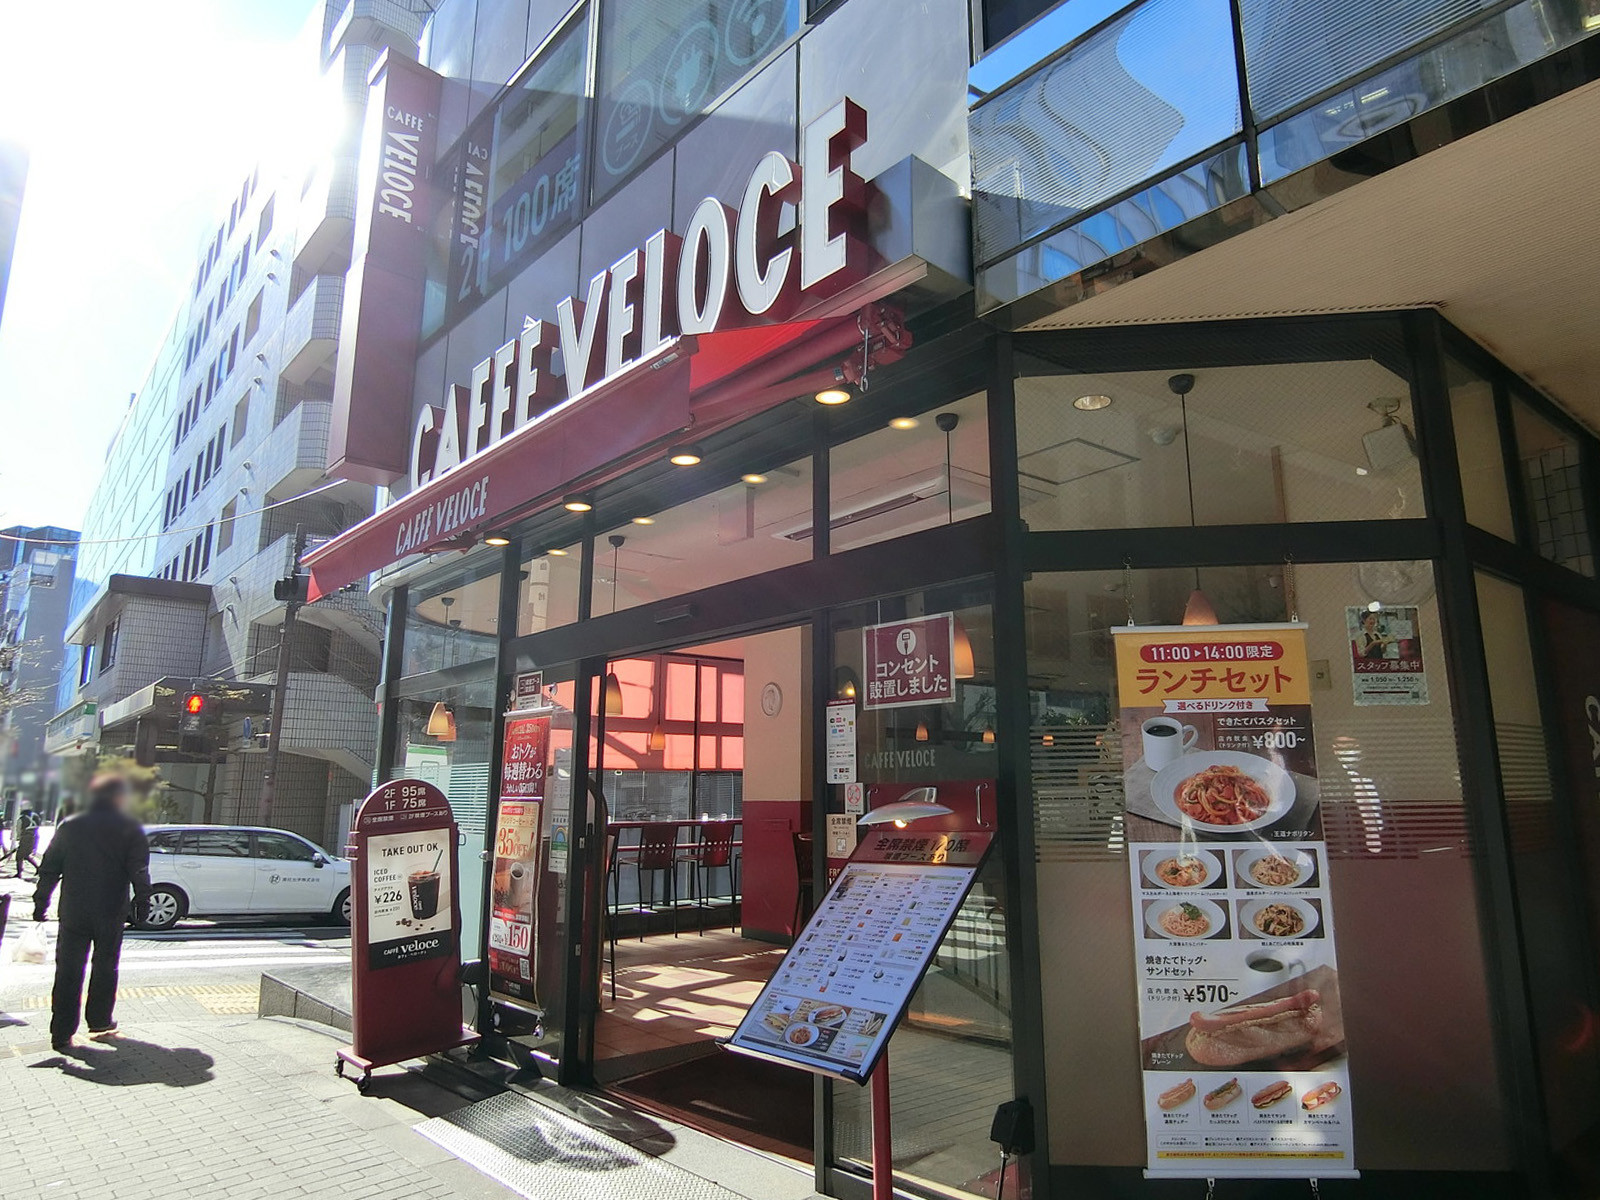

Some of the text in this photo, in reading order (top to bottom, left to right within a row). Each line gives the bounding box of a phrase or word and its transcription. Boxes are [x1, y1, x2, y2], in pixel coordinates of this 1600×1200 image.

[378, 131, 420, 223] VELOCE
[556, 96, 848, 400] VELOCE
[436, 476, 488, 535] VELOCE
[1151, 646, 1190, 661] 11:00
[876, 654, 939, 678] コンセント
[869, 674, 947, 700] 設置しました
[1136, 666, 1292, 694] ランチセット
[1177, 700, 1253, 711] 選べるドリンク付き
[1217, 716, 1296, 726] できたてパスタセット
[896, 749, 936, 768] VELOCE
[384, 788, 396, 799] 2F
[384, 800, 396, 811] 1F
[382, 842, 439, 857] TAKE OUT OK
[374, 868, 388, 876] ICED
[374, 874, 396, 883] COFFEE
[374, 890, 403, 904] ¥226
[401, 938, 440, 954] veloce
[1146, 967, 1194, 976] サンドセット
